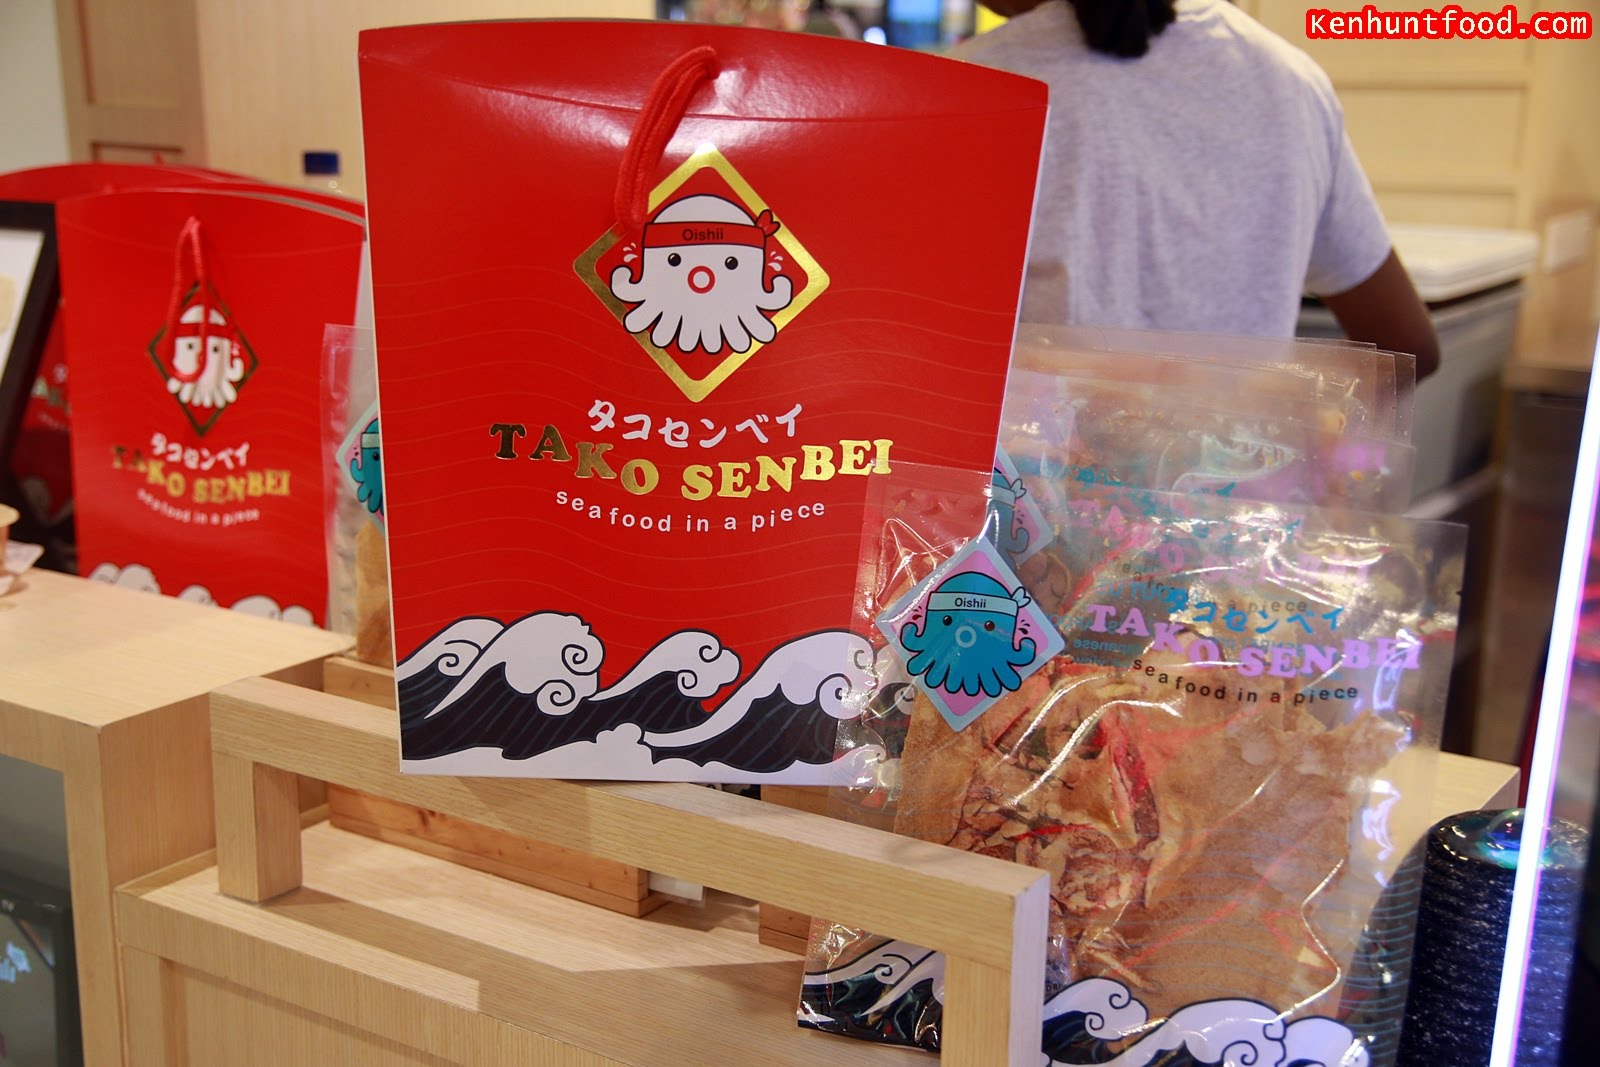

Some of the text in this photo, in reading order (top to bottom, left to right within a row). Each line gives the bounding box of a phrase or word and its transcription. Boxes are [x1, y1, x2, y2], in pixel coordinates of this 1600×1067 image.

[682, 228, 724, 241] Oishii
[587, 399, 802, 449] タコセンベイ
[113, 445, 291, 503] TAKO SENBEI
[488, 423, 894, 501] TAKO SENBEI
[686, 514, 709, 532] in
[724, 516, 737, 532] a
[752, 501, 826, 533] piece
[954, 597, 986, 608] Oishii
[1088, 604, 1220, 668] TAKO
[1237, 637, 1422, 679] SENBEI
[1238, 688, 1258, 703] in
[1270, 691, 1281, 704] a
[1293, 687, 1358, 706] piece
